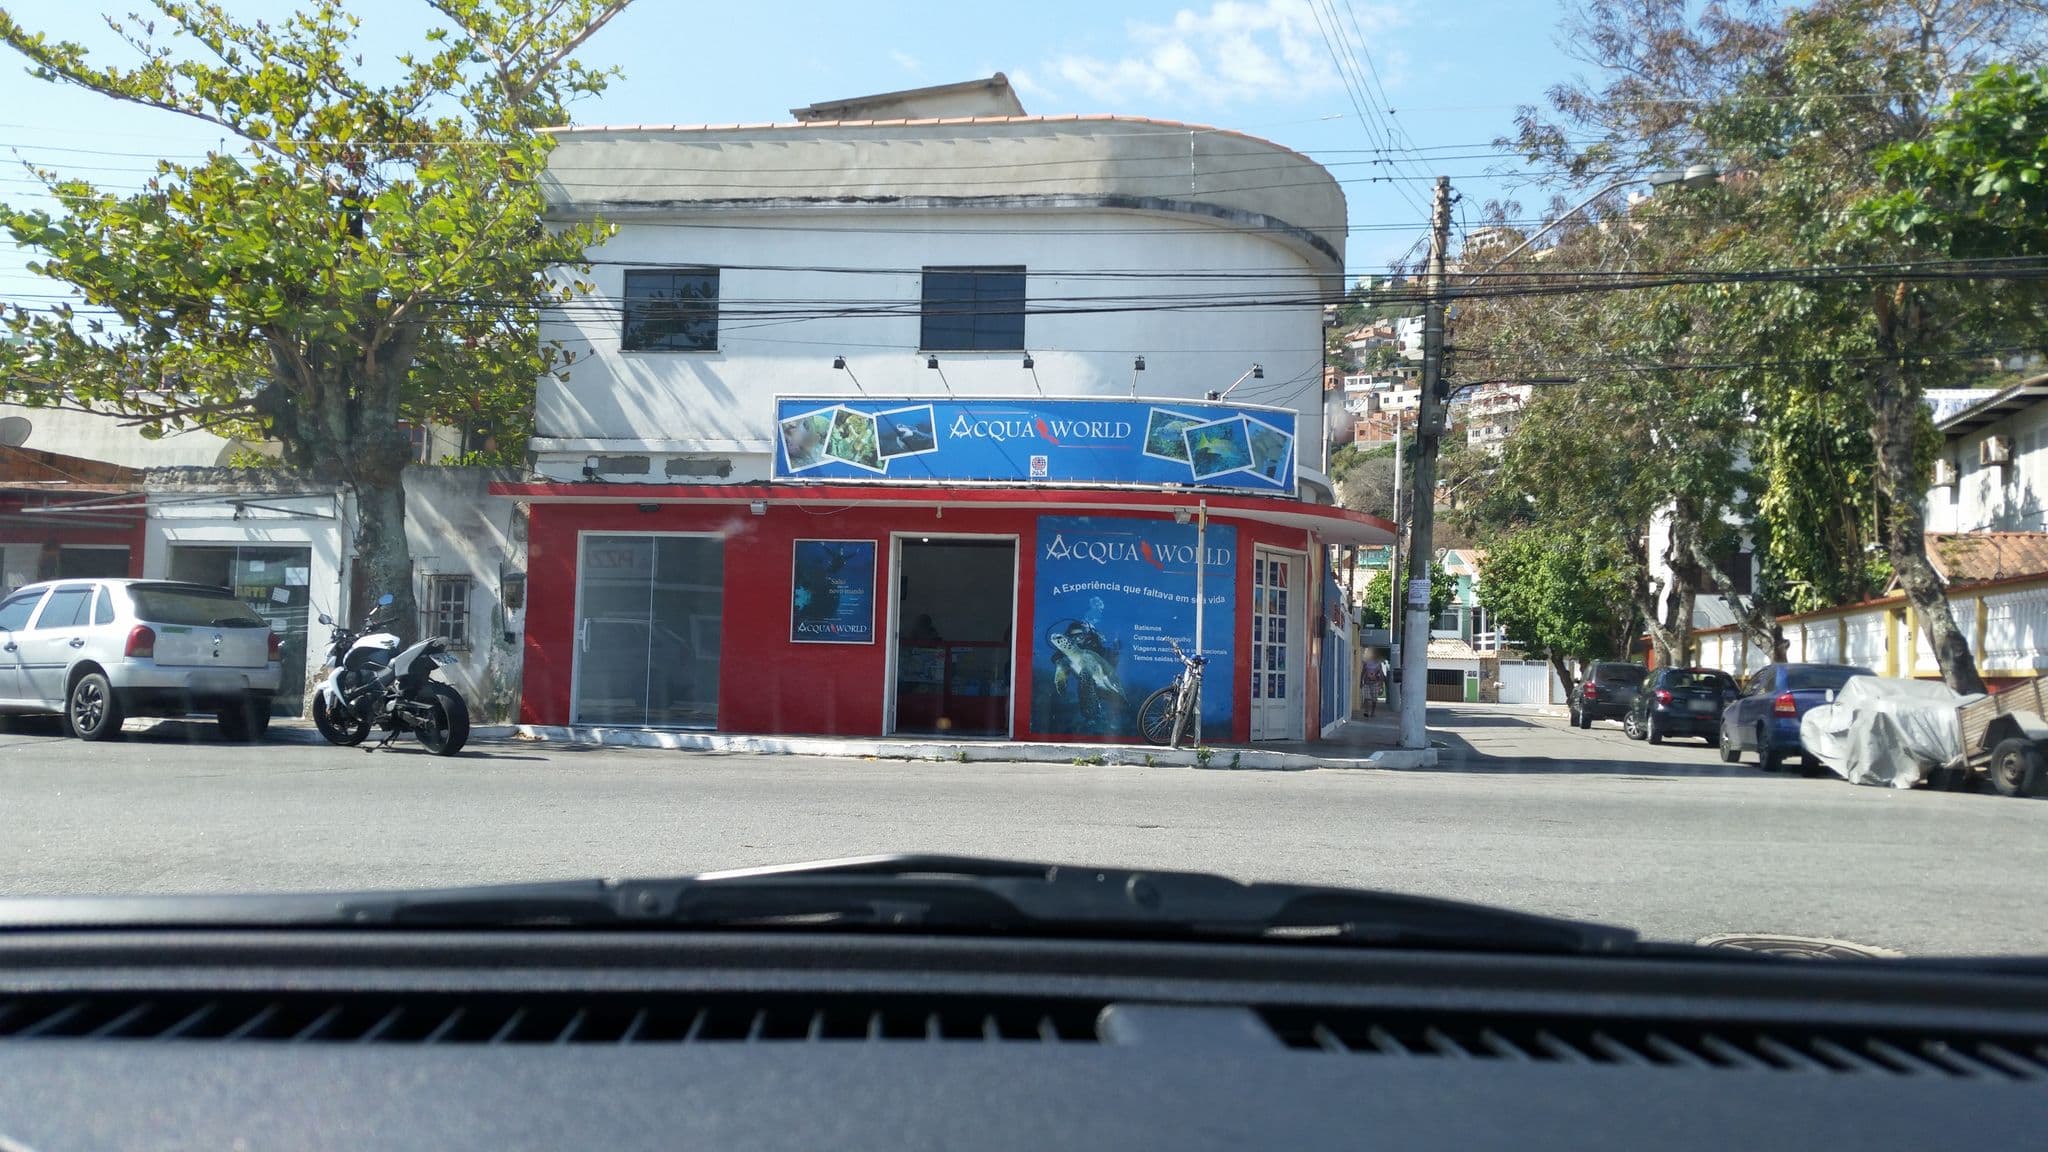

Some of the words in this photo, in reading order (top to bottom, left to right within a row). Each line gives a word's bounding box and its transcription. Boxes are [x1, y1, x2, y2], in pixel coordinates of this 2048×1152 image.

[950, 414, 1035, 441] ACQUA
[1050, 421, 1131, 438] WORLD
[1046, 534, 1139, 564] ACQUA
[1155, 544, 1230, 566] WOLD
[1053, 586, 1061, 596] A
[1062, 580, 1120, 593] Experiência
[1123, 585, 1141, 595] que
[1143, 586, 1174, 601] faltava
[1175, 594, 1189, 603] em
[1208, 594, 1225, 604] vida
[798, 622, 830, 634] ACQUA
[836, 624, 867, 633] WORLD
